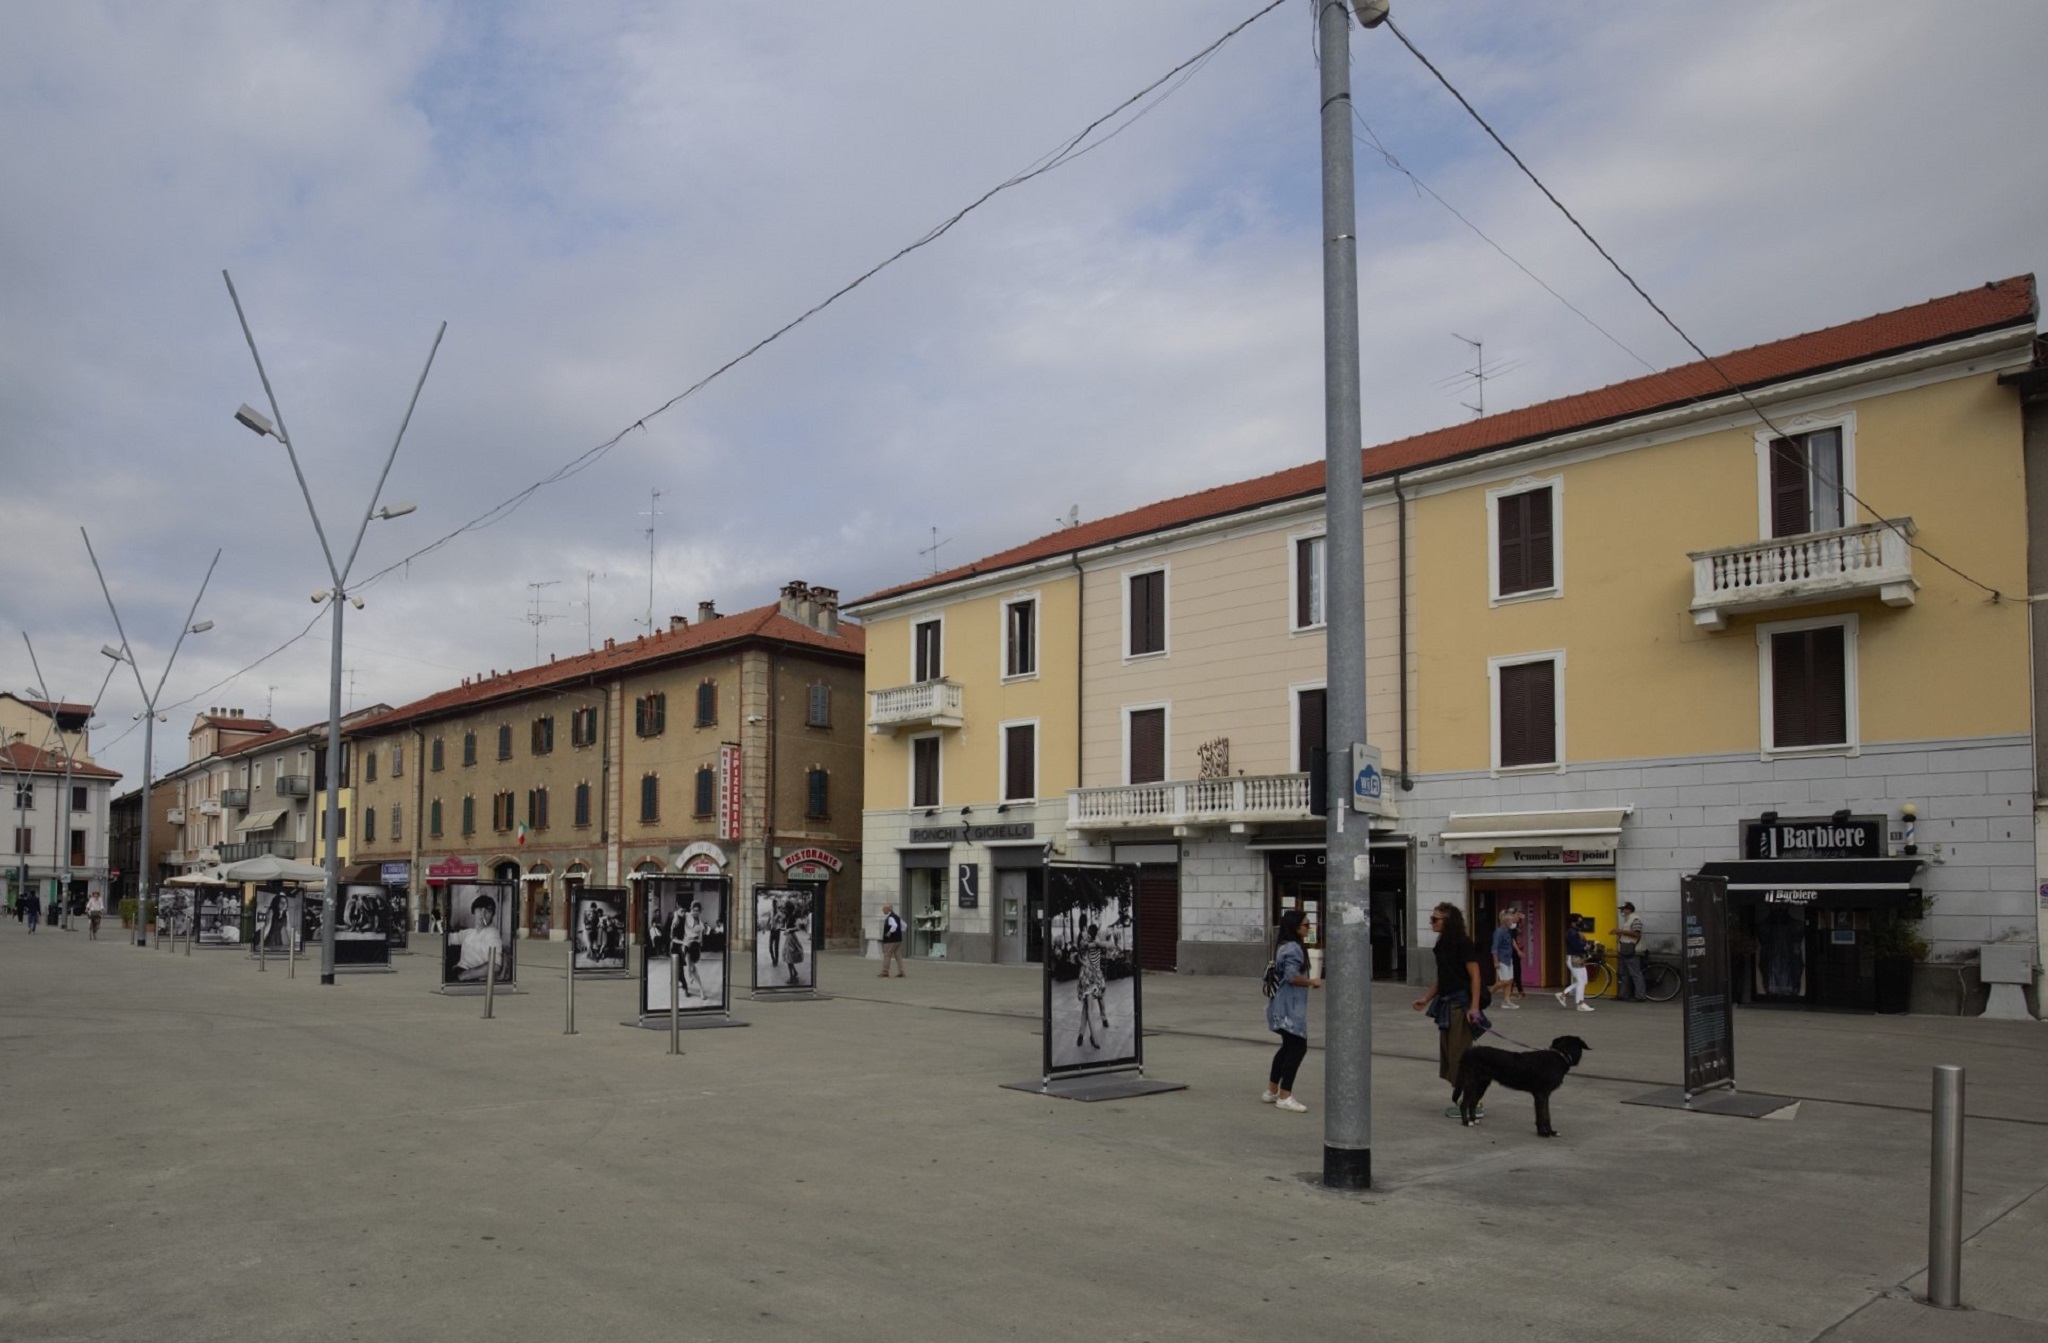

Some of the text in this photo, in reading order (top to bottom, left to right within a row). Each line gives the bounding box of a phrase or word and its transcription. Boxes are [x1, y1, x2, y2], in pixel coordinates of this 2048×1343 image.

[732, 759, 740, 828] PIZZERIA
[1782, 825, 1866, 849] Barbiere
[785, 849, 839, 867] RISTORANTE
[1582, 849, 1609, 862] point
[1776, 889, 1818, 900] Barbiere
